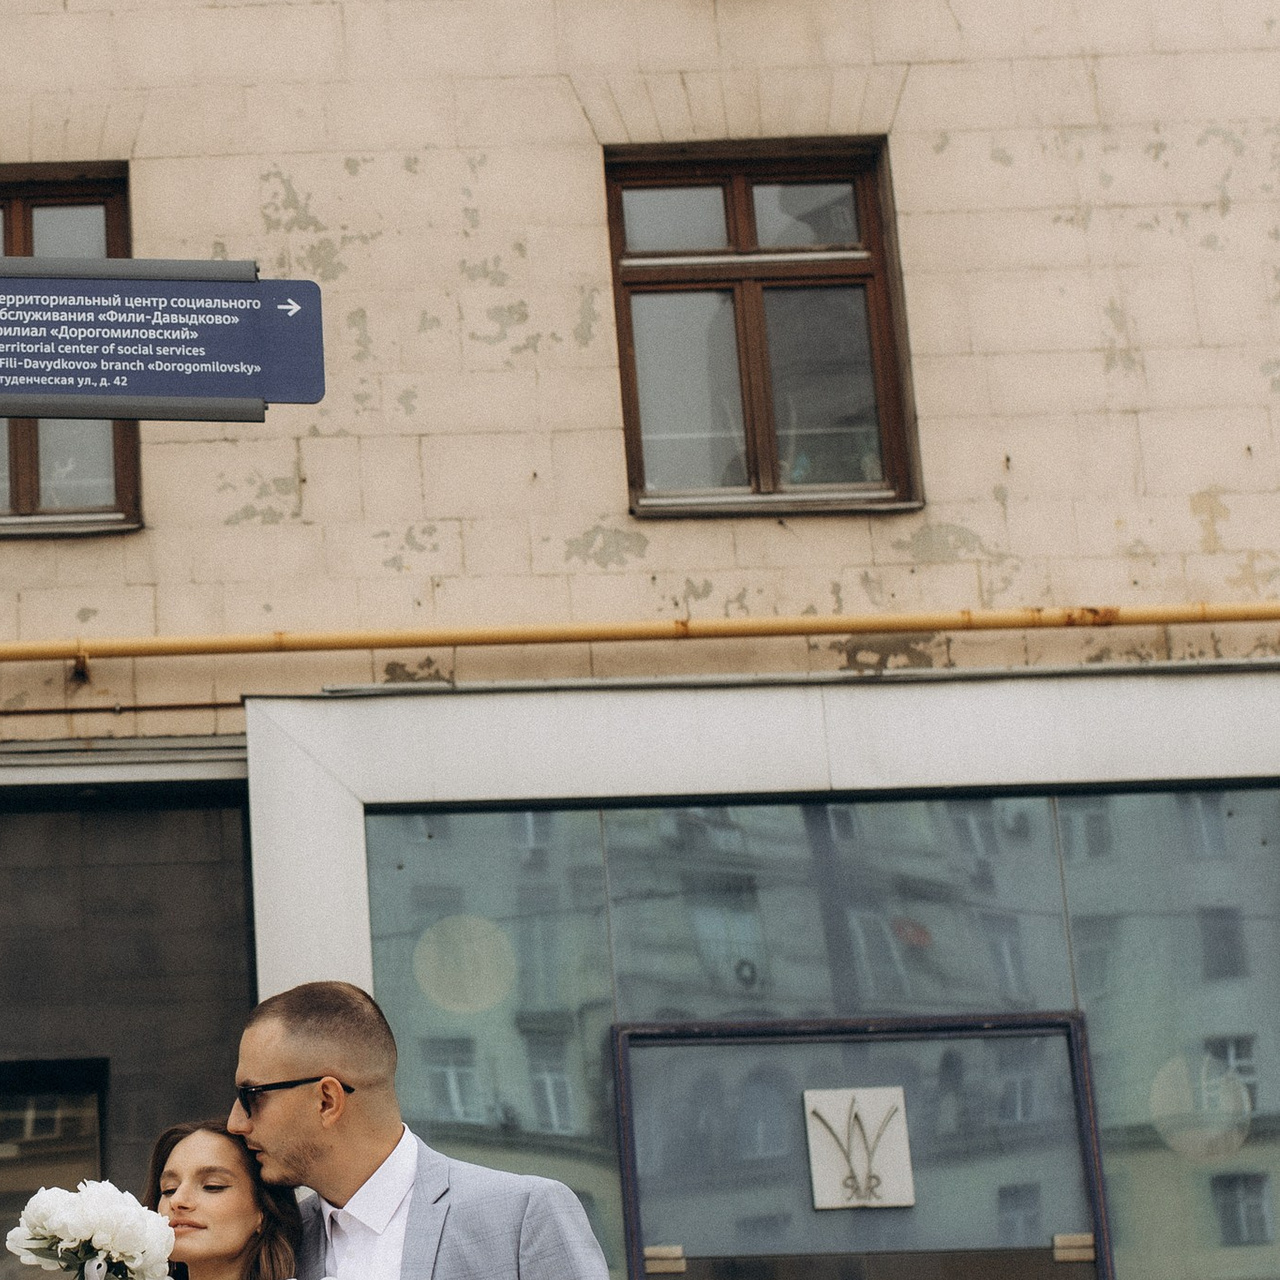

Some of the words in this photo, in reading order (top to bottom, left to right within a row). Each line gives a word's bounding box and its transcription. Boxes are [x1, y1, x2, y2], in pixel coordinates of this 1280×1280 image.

[125, 297, 167, 310] центр
[171, 298, 260, 309] социального
[98, 311, 239, 325] «Фили-Давыдково»
[51, 326, 198, 340] «Дорогомиловский»
[58, 344, 99, 353] center
[102, 343, 115, 354] of
[118, 344, 153, 354] social
[156, 345, 205, 355] services
[101, 359, 144, 370] branch
[148, 361, 261, 375] «Dorogomilovsky»
[78, 378, 97, 387] ул.,
[100, 378, 110, 386] д.
[114, 376, 127, 385] 42
